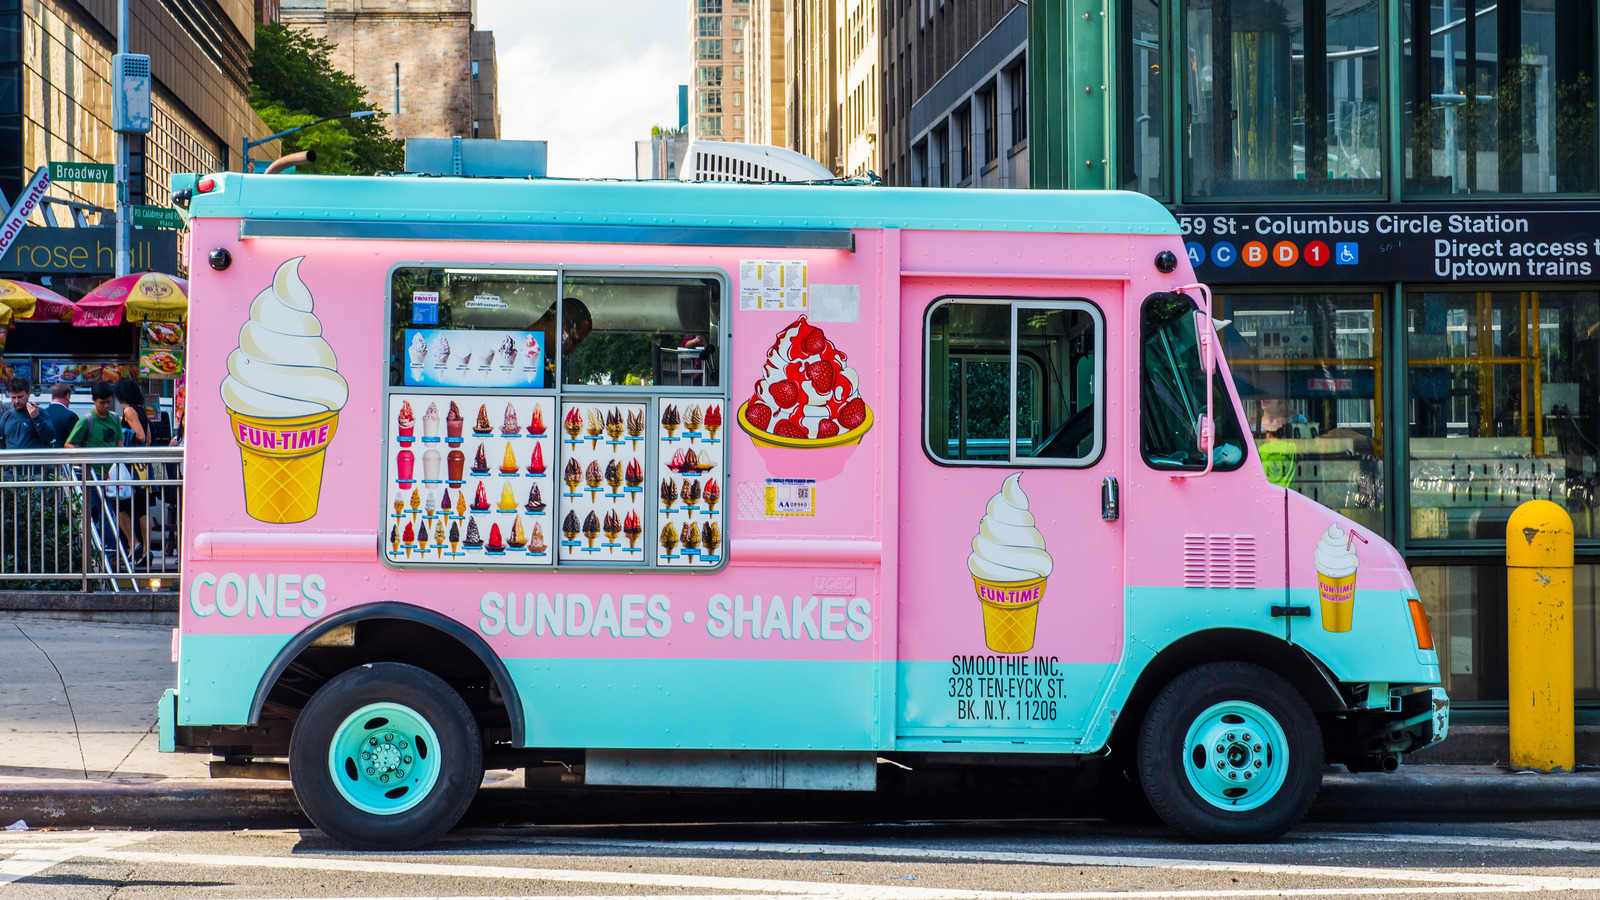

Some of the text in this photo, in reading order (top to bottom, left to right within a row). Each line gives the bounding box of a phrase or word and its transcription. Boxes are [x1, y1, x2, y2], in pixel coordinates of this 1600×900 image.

[56, 164, 109, 182] Broadway
[20, 172, 50, 217] center
[142, 208, 164, 219] Calabrese
[165, 210, 173, 220] and
[1180, 217, 1207, 235] 59
[1213, 216, 1237, 235] St
[1255, 216, 1370, 235] Columbus
[1375, 215, 1442, 234] Circle
[1448, 214, 1529, 233] Station
[17, 245, 88, 268] rose
[1188, 246, 1320, 262] A C B D 1
[1434, 239, 1503, 257] Direct
[1509, 242, 1588, 257] access
[1434, 257, 1592, 280] Uptown trains
[238, 422, 330, 450] FUN-TIME
[190, 572, 326, 618] CONES
[979, 585, 1041, 603] FUN-TIME
[1320, 582, 1353, 594] FUN-TIME
[479, 592, 872, 641] SUNDAES SHAKES
[952, 655, 1063, 676] SMOOTHIE INC.
[948, 677, 1067, 698] 328 TEN-EYCK ST.
[958, 700, 1057, 721] BK. N.Y. 11206
